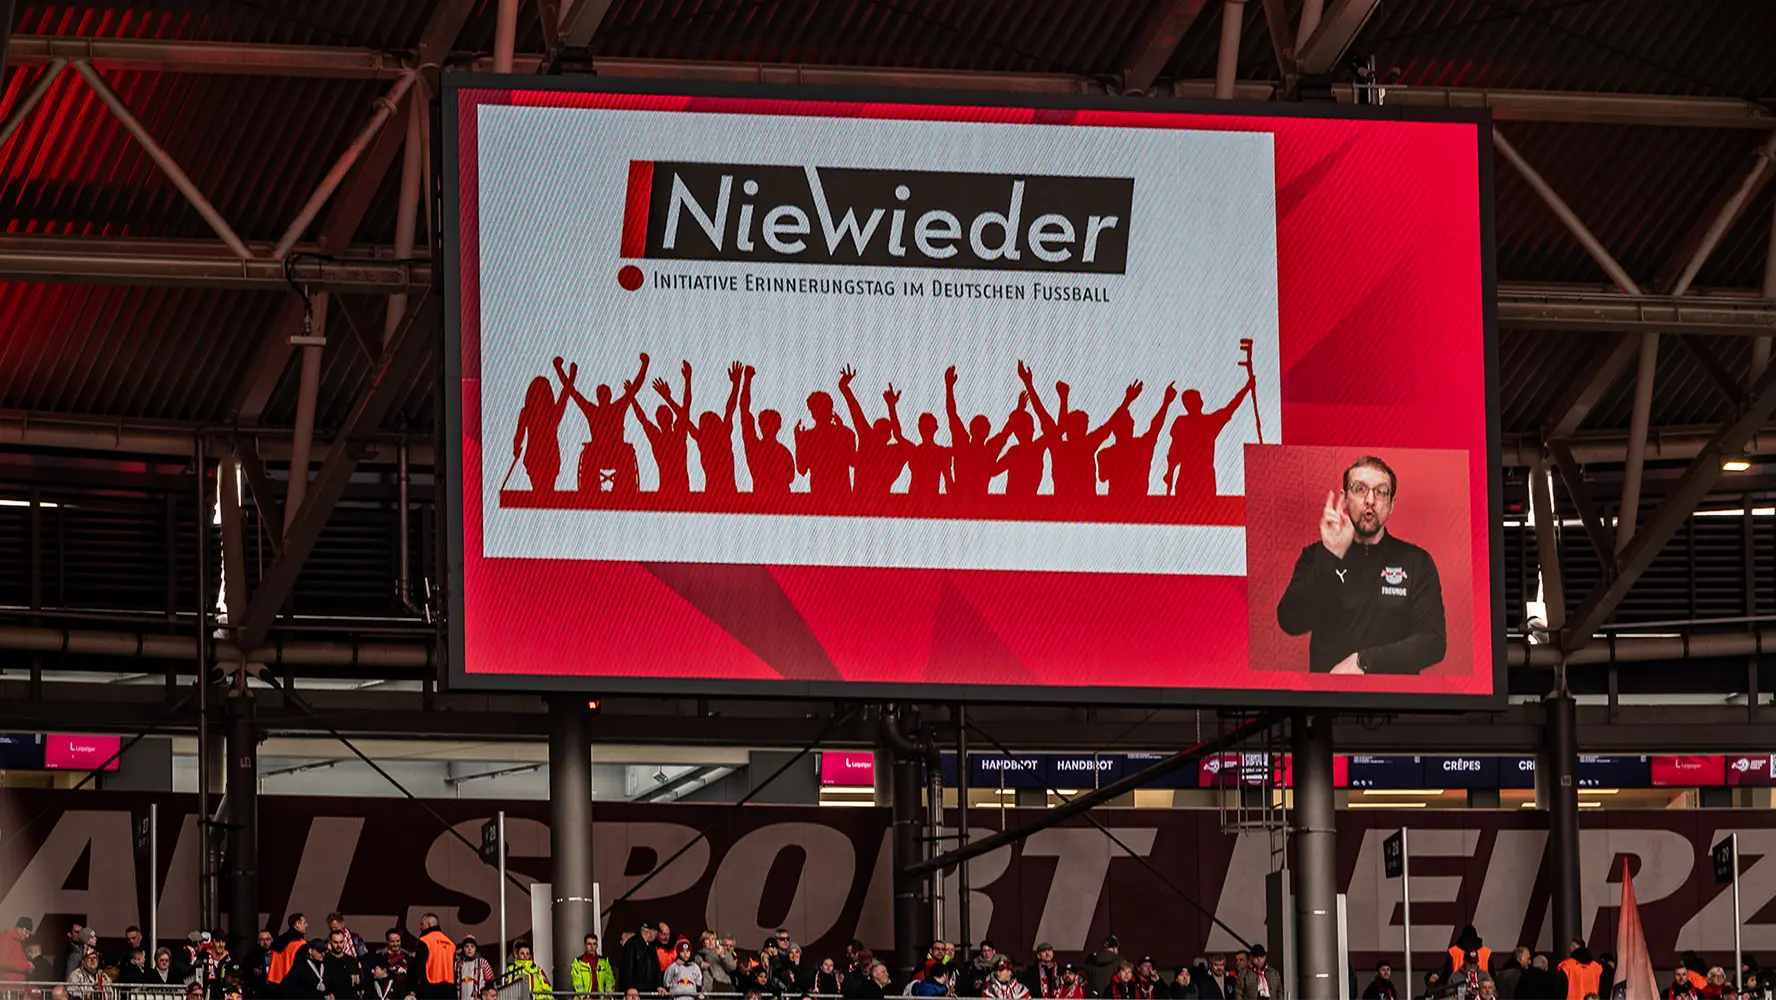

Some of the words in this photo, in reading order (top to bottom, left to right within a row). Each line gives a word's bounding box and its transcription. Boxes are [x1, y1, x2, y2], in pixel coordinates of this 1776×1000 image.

[653, 270, 738, 292] INITIATIVE
[745, 273, 896, 297] ERINNERUNGSTAG
[904, 282, 925, 297] IM
[932, 279, 1026, 301] DEUTSCHEN
[1033, 283, 1110, 303] FUSSBALL
[981, 759, 1038, 770] HANDBROT
[1057, 760, 1114, 771] HANDBROT
[1442, 758, 1481, 771] CRÊPES
